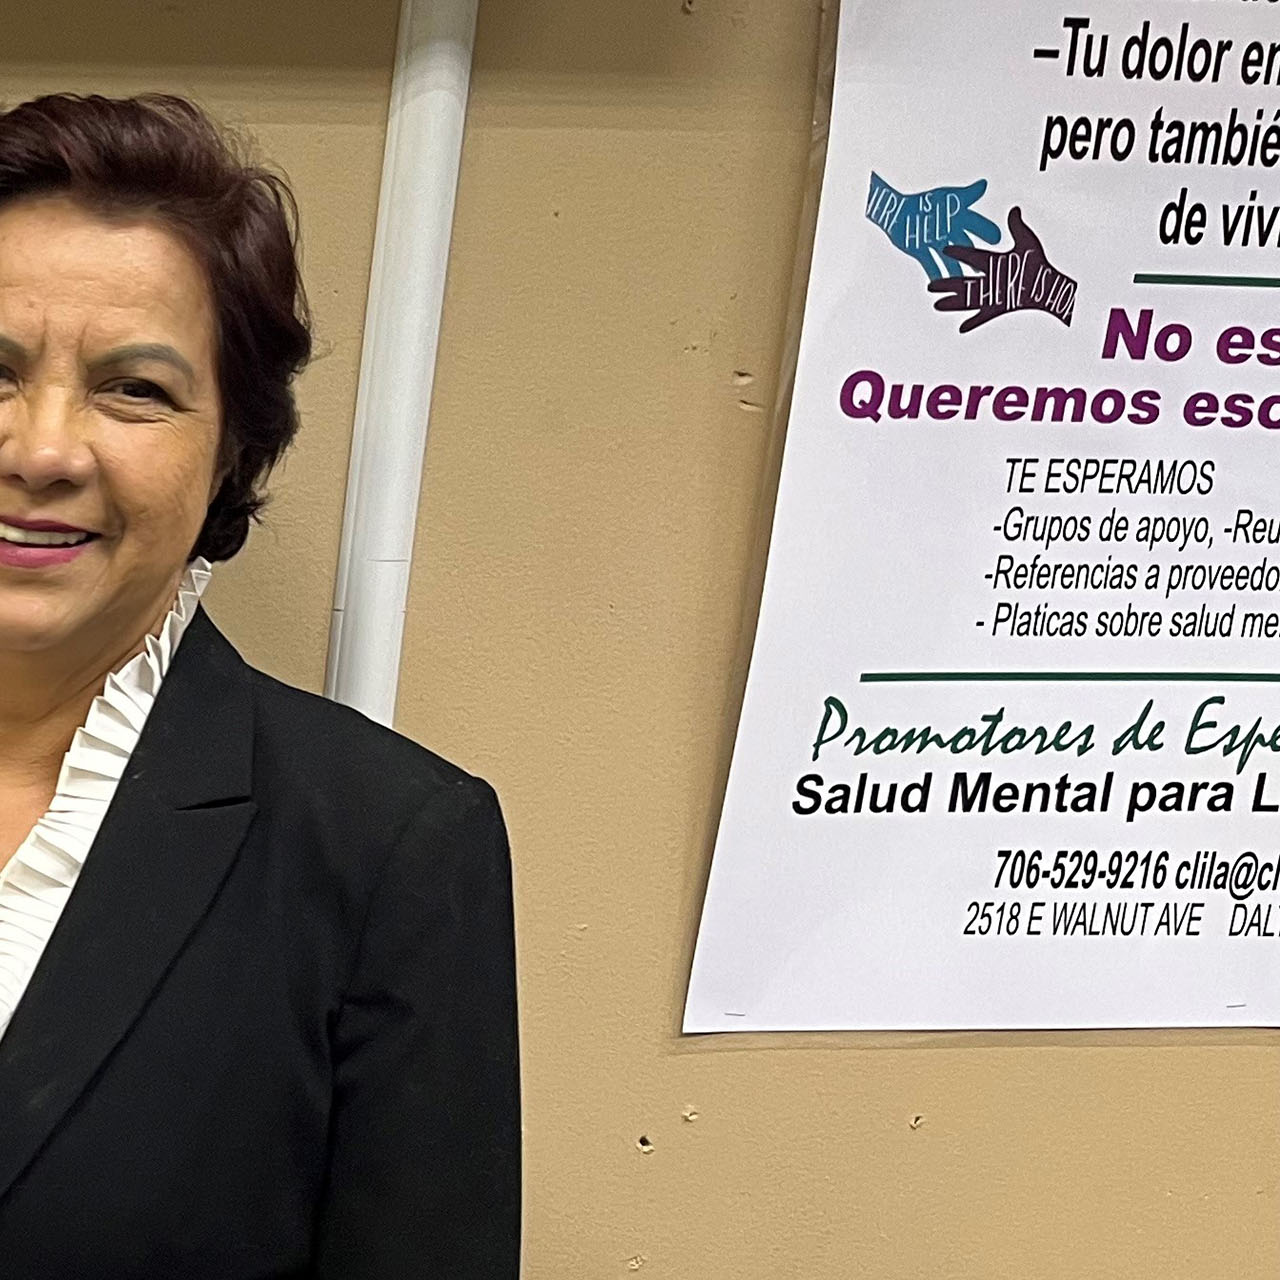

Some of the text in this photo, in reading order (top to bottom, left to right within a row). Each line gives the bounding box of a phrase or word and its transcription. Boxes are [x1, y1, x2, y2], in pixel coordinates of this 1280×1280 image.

[1122, 21, 1233, 83] dolor
[1040, 116, 1135, 171] pero
[906, 193, 960, 249] HELP
[1159, 187, 1280, 248] de viv
[964, 250, 1033, 310] THERE
[1030, 264, 1051, 303] IS
[1102, 308, 1280, 366] No es
[840, 370, 1161, 425] Queremos
[1006, 458, 1215, 495] TE ESPERAMOS
[994, 507, 1091, 547] -Grupos
[1099, 507, 1128, 542] de
[1136, 517, 1213, 552] apoyo,
[985, 554, 1280, 599] -Referencias a proveedo
[992, 602, 1088, 637] Platicas
[1096, 603, 1162, 637] sobre
[1169, 603, 1236, 637] salud
[812, 696, 1094, 761] Promotores
[1112, 699, 1165, 755] de
[792, 772, 932, 815] Salud
[948, 771, 1114, 812] Mental
[1126, 782, 1234, 822] para
[995, 850, 1169, 889] 706-529-9216
[963, 902, 1280, 937] 2518 E WALNUT AVE DAL
